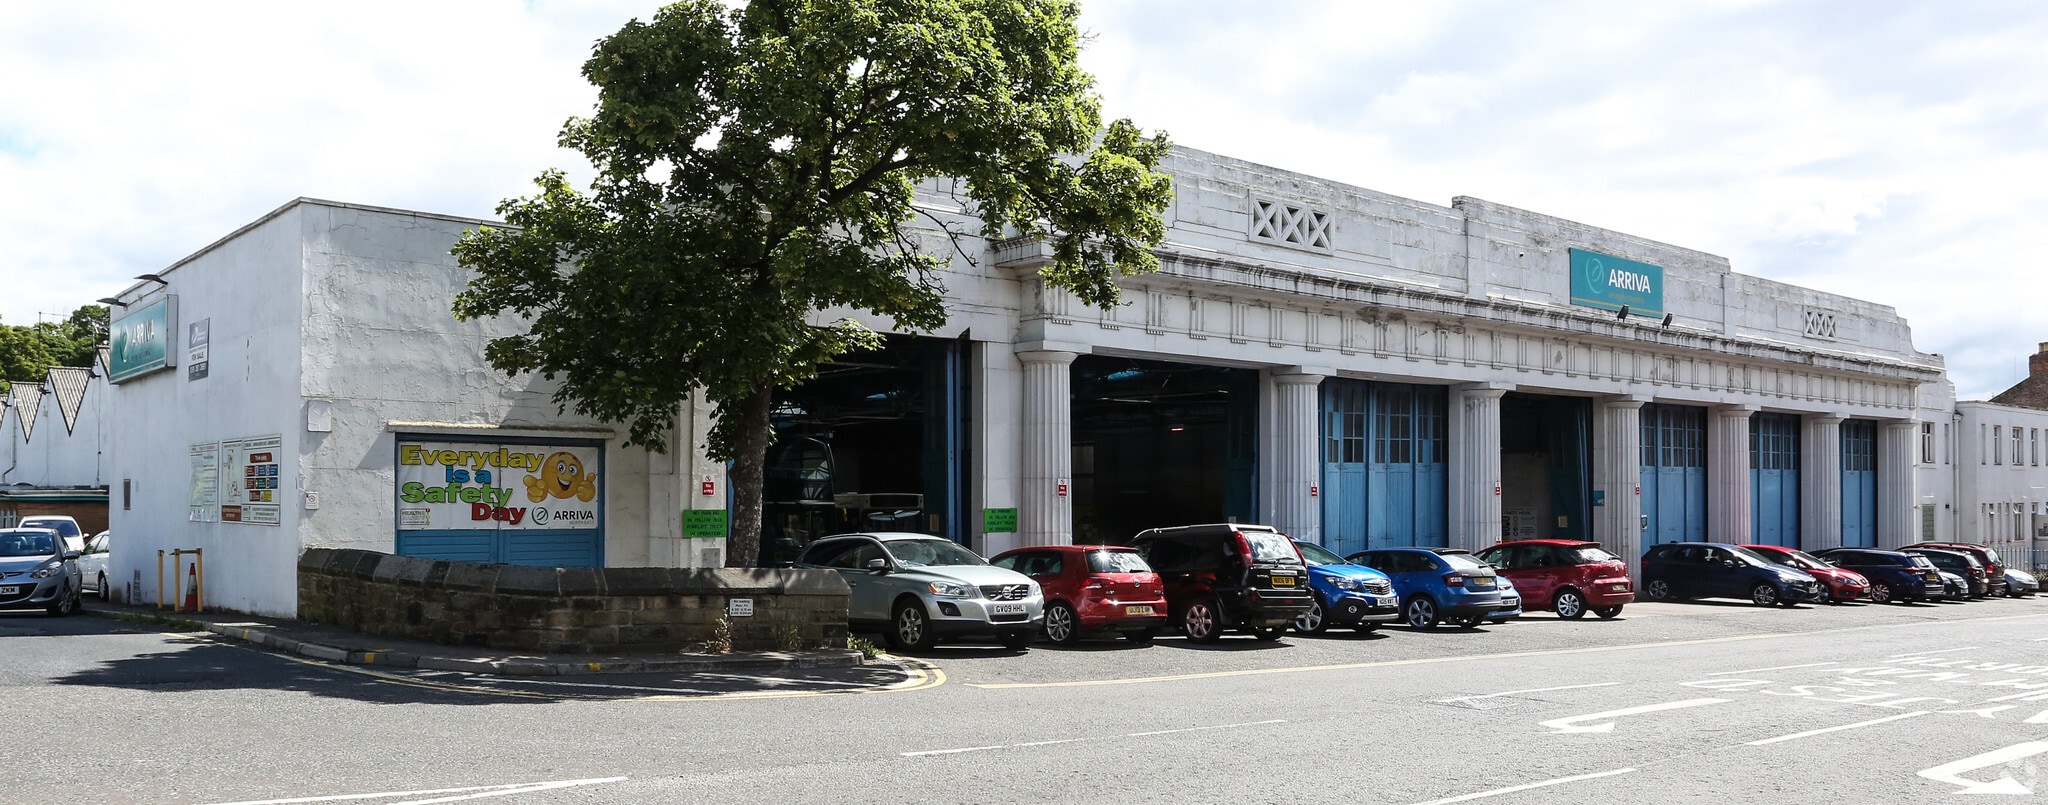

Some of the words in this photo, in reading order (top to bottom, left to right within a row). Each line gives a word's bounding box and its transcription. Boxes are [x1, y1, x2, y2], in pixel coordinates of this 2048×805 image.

[1608, 268, 1651, 293] ARRIVA
[131, 319, 155, 347] ARRIVA
[400, 444, 544, 472] Everyday
[474, 469, 491, 484] a
[400, 482, 513, 508] Safety
[471, 502, 527, 526] Day
[553, 510, 594, 520] ARRIVA
[996, 605, 1012, 613] GV09
[1013, 604, 1025, 612] HHL
